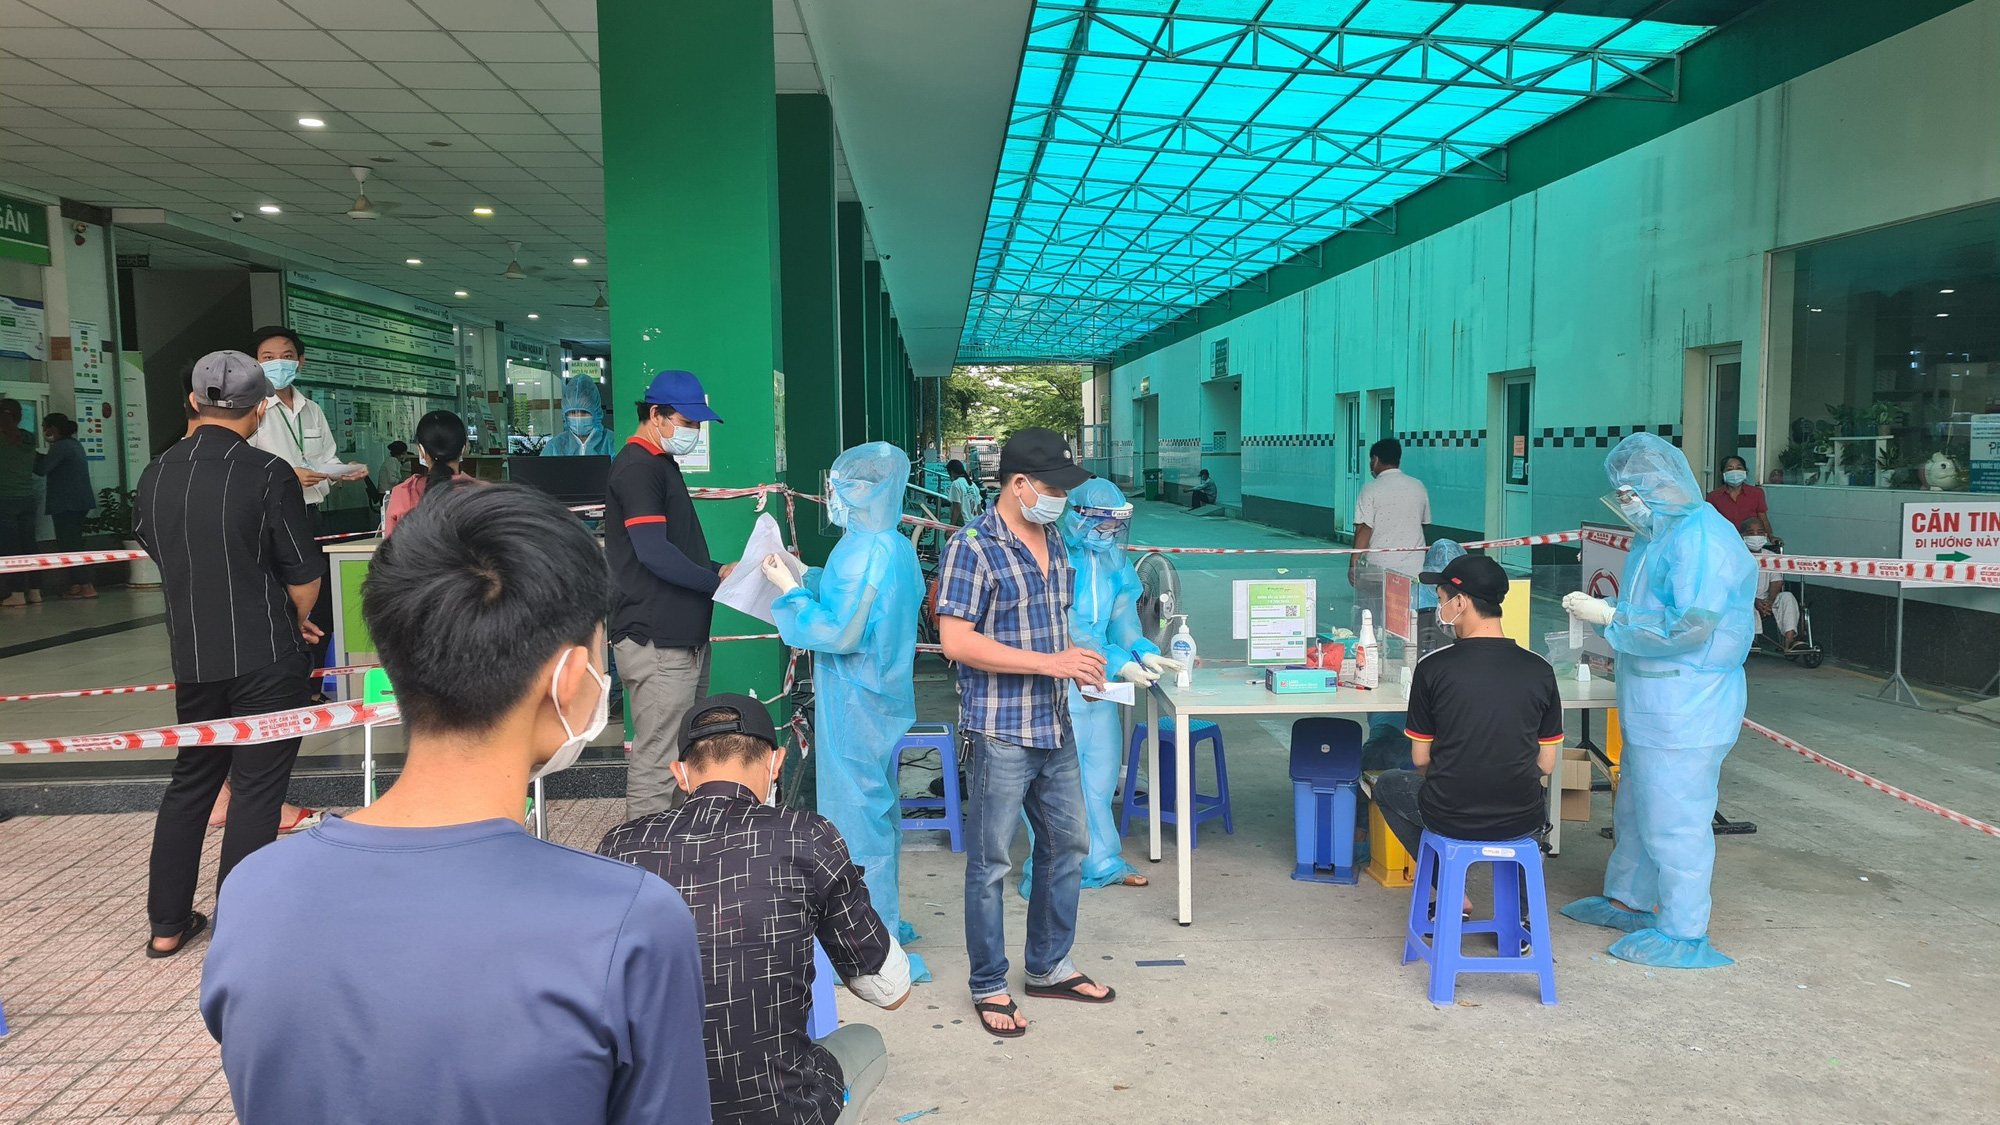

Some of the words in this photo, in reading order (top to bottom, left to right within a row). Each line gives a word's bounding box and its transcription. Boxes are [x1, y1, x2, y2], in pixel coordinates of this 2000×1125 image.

[1912, 508, 1960, 533] CĂN
[1968, 512, 2000, 532] TIN
[1915, 538, 1927, 548] ĐI
[1930, 536, 1973, 548] HƯỚNG
[1976, 534, 2000, 547] NÀY
